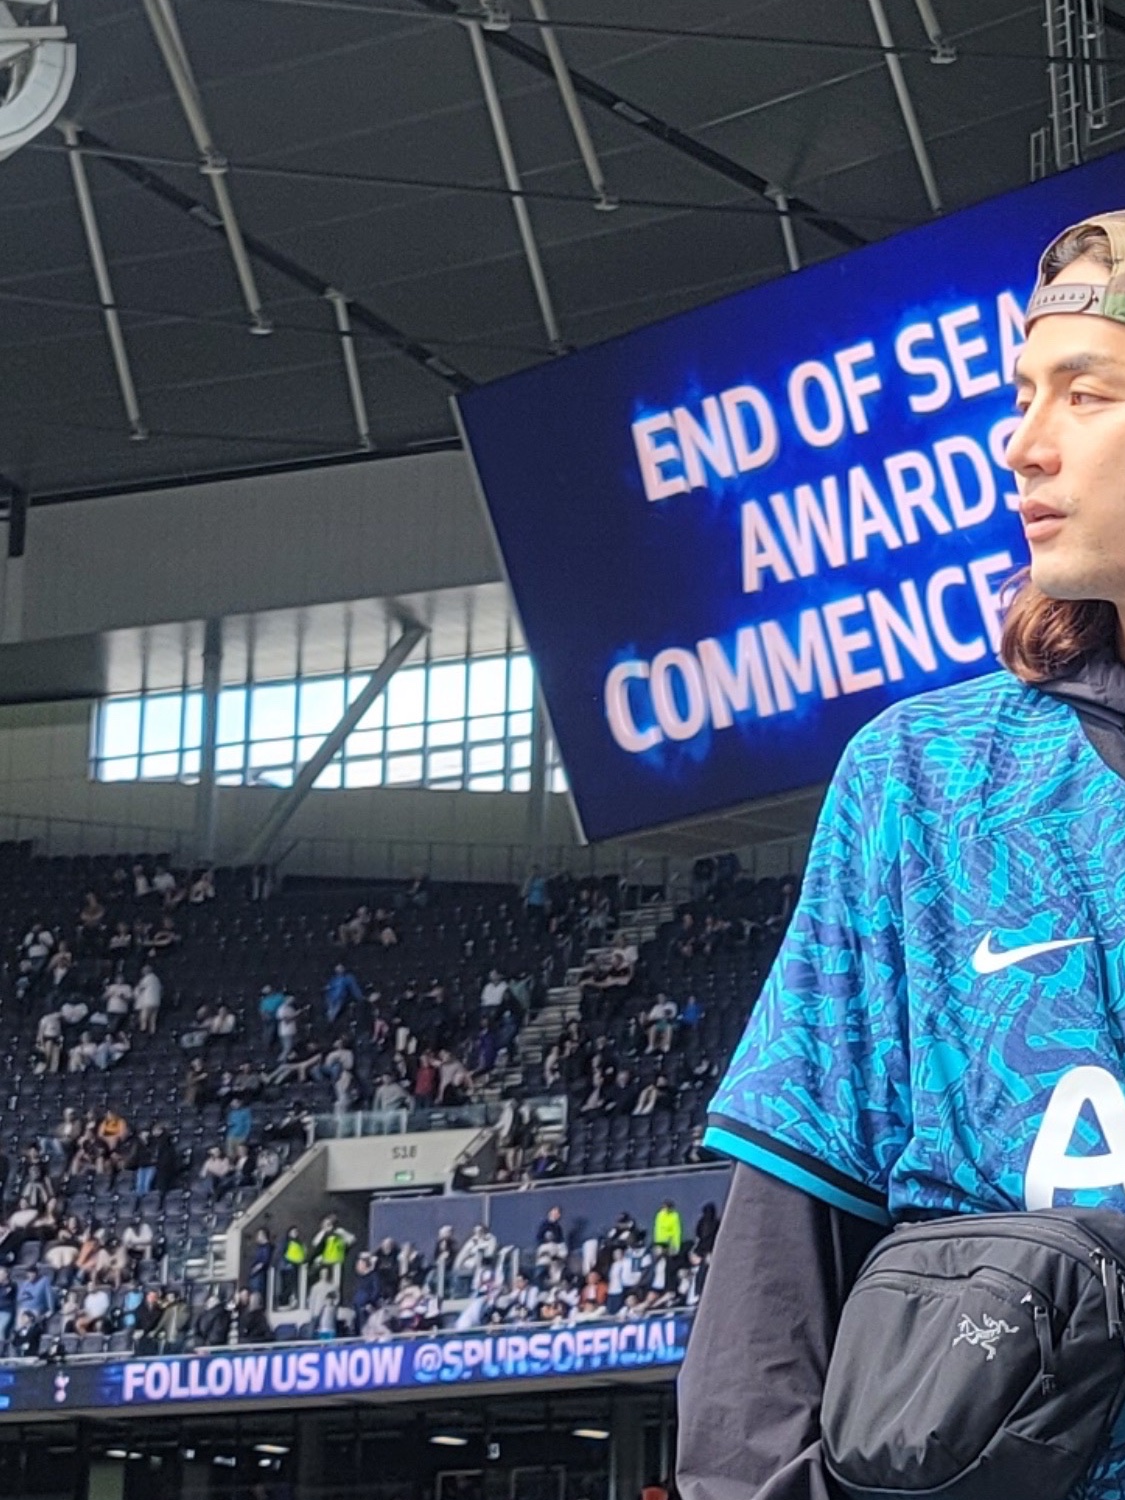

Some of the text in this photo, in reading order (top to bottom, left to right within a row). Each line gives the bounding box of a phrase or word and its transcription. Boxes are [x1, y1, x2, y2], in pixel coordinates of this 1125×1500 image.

[631, 385, 779, 502] END
[788, 341, 882, 448] OF
[604, 549, 1016, 754] COMMENCE
[123, 1320, 686, 1401] FOLLOW US NOW @SPURSOFFICIAL
